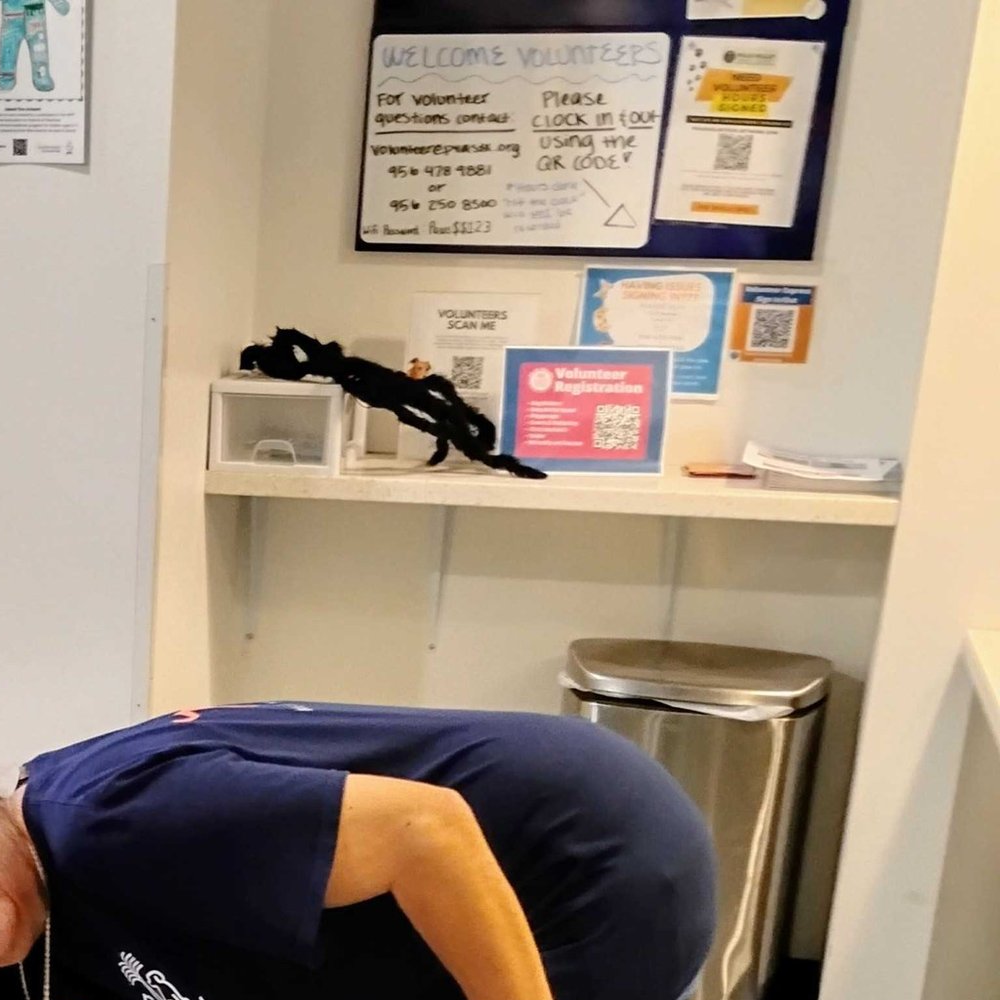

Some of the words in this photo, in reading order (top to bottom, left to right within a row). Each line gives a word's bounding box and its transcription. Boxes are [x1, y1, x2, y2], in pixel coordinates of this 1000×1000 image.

[382, 45, 507, 68] WELCOME
[517, 42, 662, 68] VOLUNTEERS
[542, 90, 608, 108] Please
[536, 155, 566, 171] QR
[427, 183, 447, 192] or
[427, 199, 457, 211] 250
[438, 309, 508, 320] VOLUNTEERS
[447, 320, 477, 330] SCAN
[480, 321, 497, 330] ME
[554, 367, 628, 380] Volunteer
[554, 381, 643, 396] Registration
